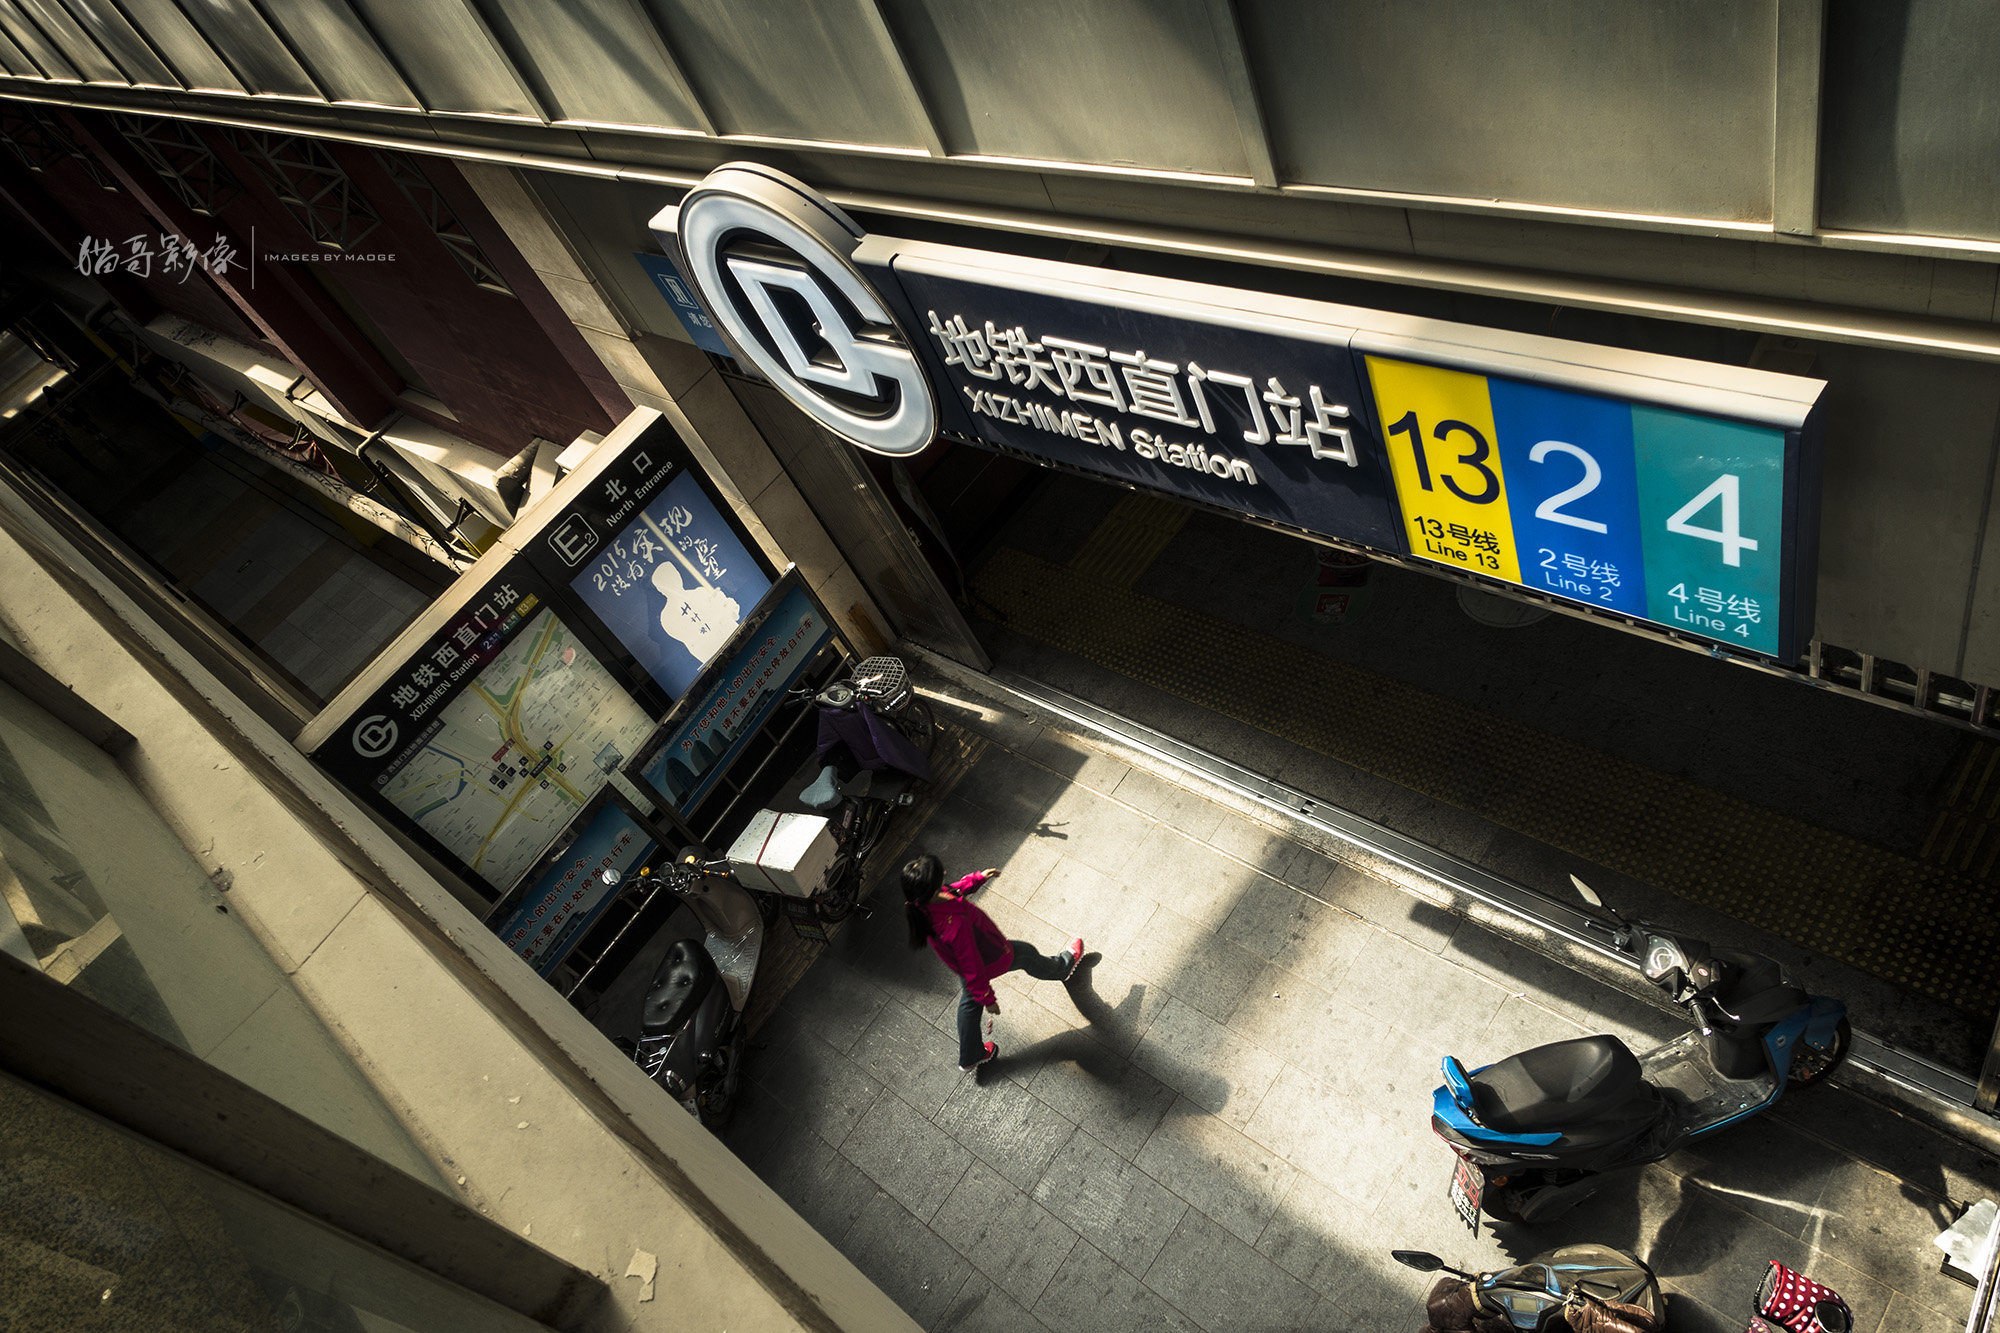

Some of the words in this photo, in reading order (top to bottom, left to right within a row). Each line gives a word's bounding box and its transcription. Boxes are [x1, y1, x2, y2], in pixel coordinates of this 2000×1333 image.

[928, 310, 1359, 468] 地铁西直门站
[963, 385, 1128, 451] XIZHIMEN
[1129, 427, 1258, 486] Station
[1387, 410, 1501, 505] 13
[605, 498, 635, 528] North
[634, 460, 673, 499] Entrance
[1528, 440, 1608, 534] 2
[1413, 515, 1501, 555] 13号线
[1666, 473, 1758, 568] 4
[592, 539, 627, 592] 2015
[632, 505, 693, 563] 实现
[1425, 538, 1468, 562] Line
[1478, 552, 1500, 570] 13
[1537, 547, 1621, 588] 2号线
[517, 603, 530, 615] 13
[1545, 571, 1592, 596] Line
[1599, 586, 1613, 602] 2
[1667, 582, 1761, 624] 4号线
[390, 583, 520, 709] 地铁西直门站
[482, 640, 492, 650] 2
[501, 622, 510, 632] 4
[1673, 605, 1726, 632] Line
[1734, 622, 1750, 637] 4
[409, 679, 452, 722] XIZHIMEN
[450, 652, 480, 682] Station
